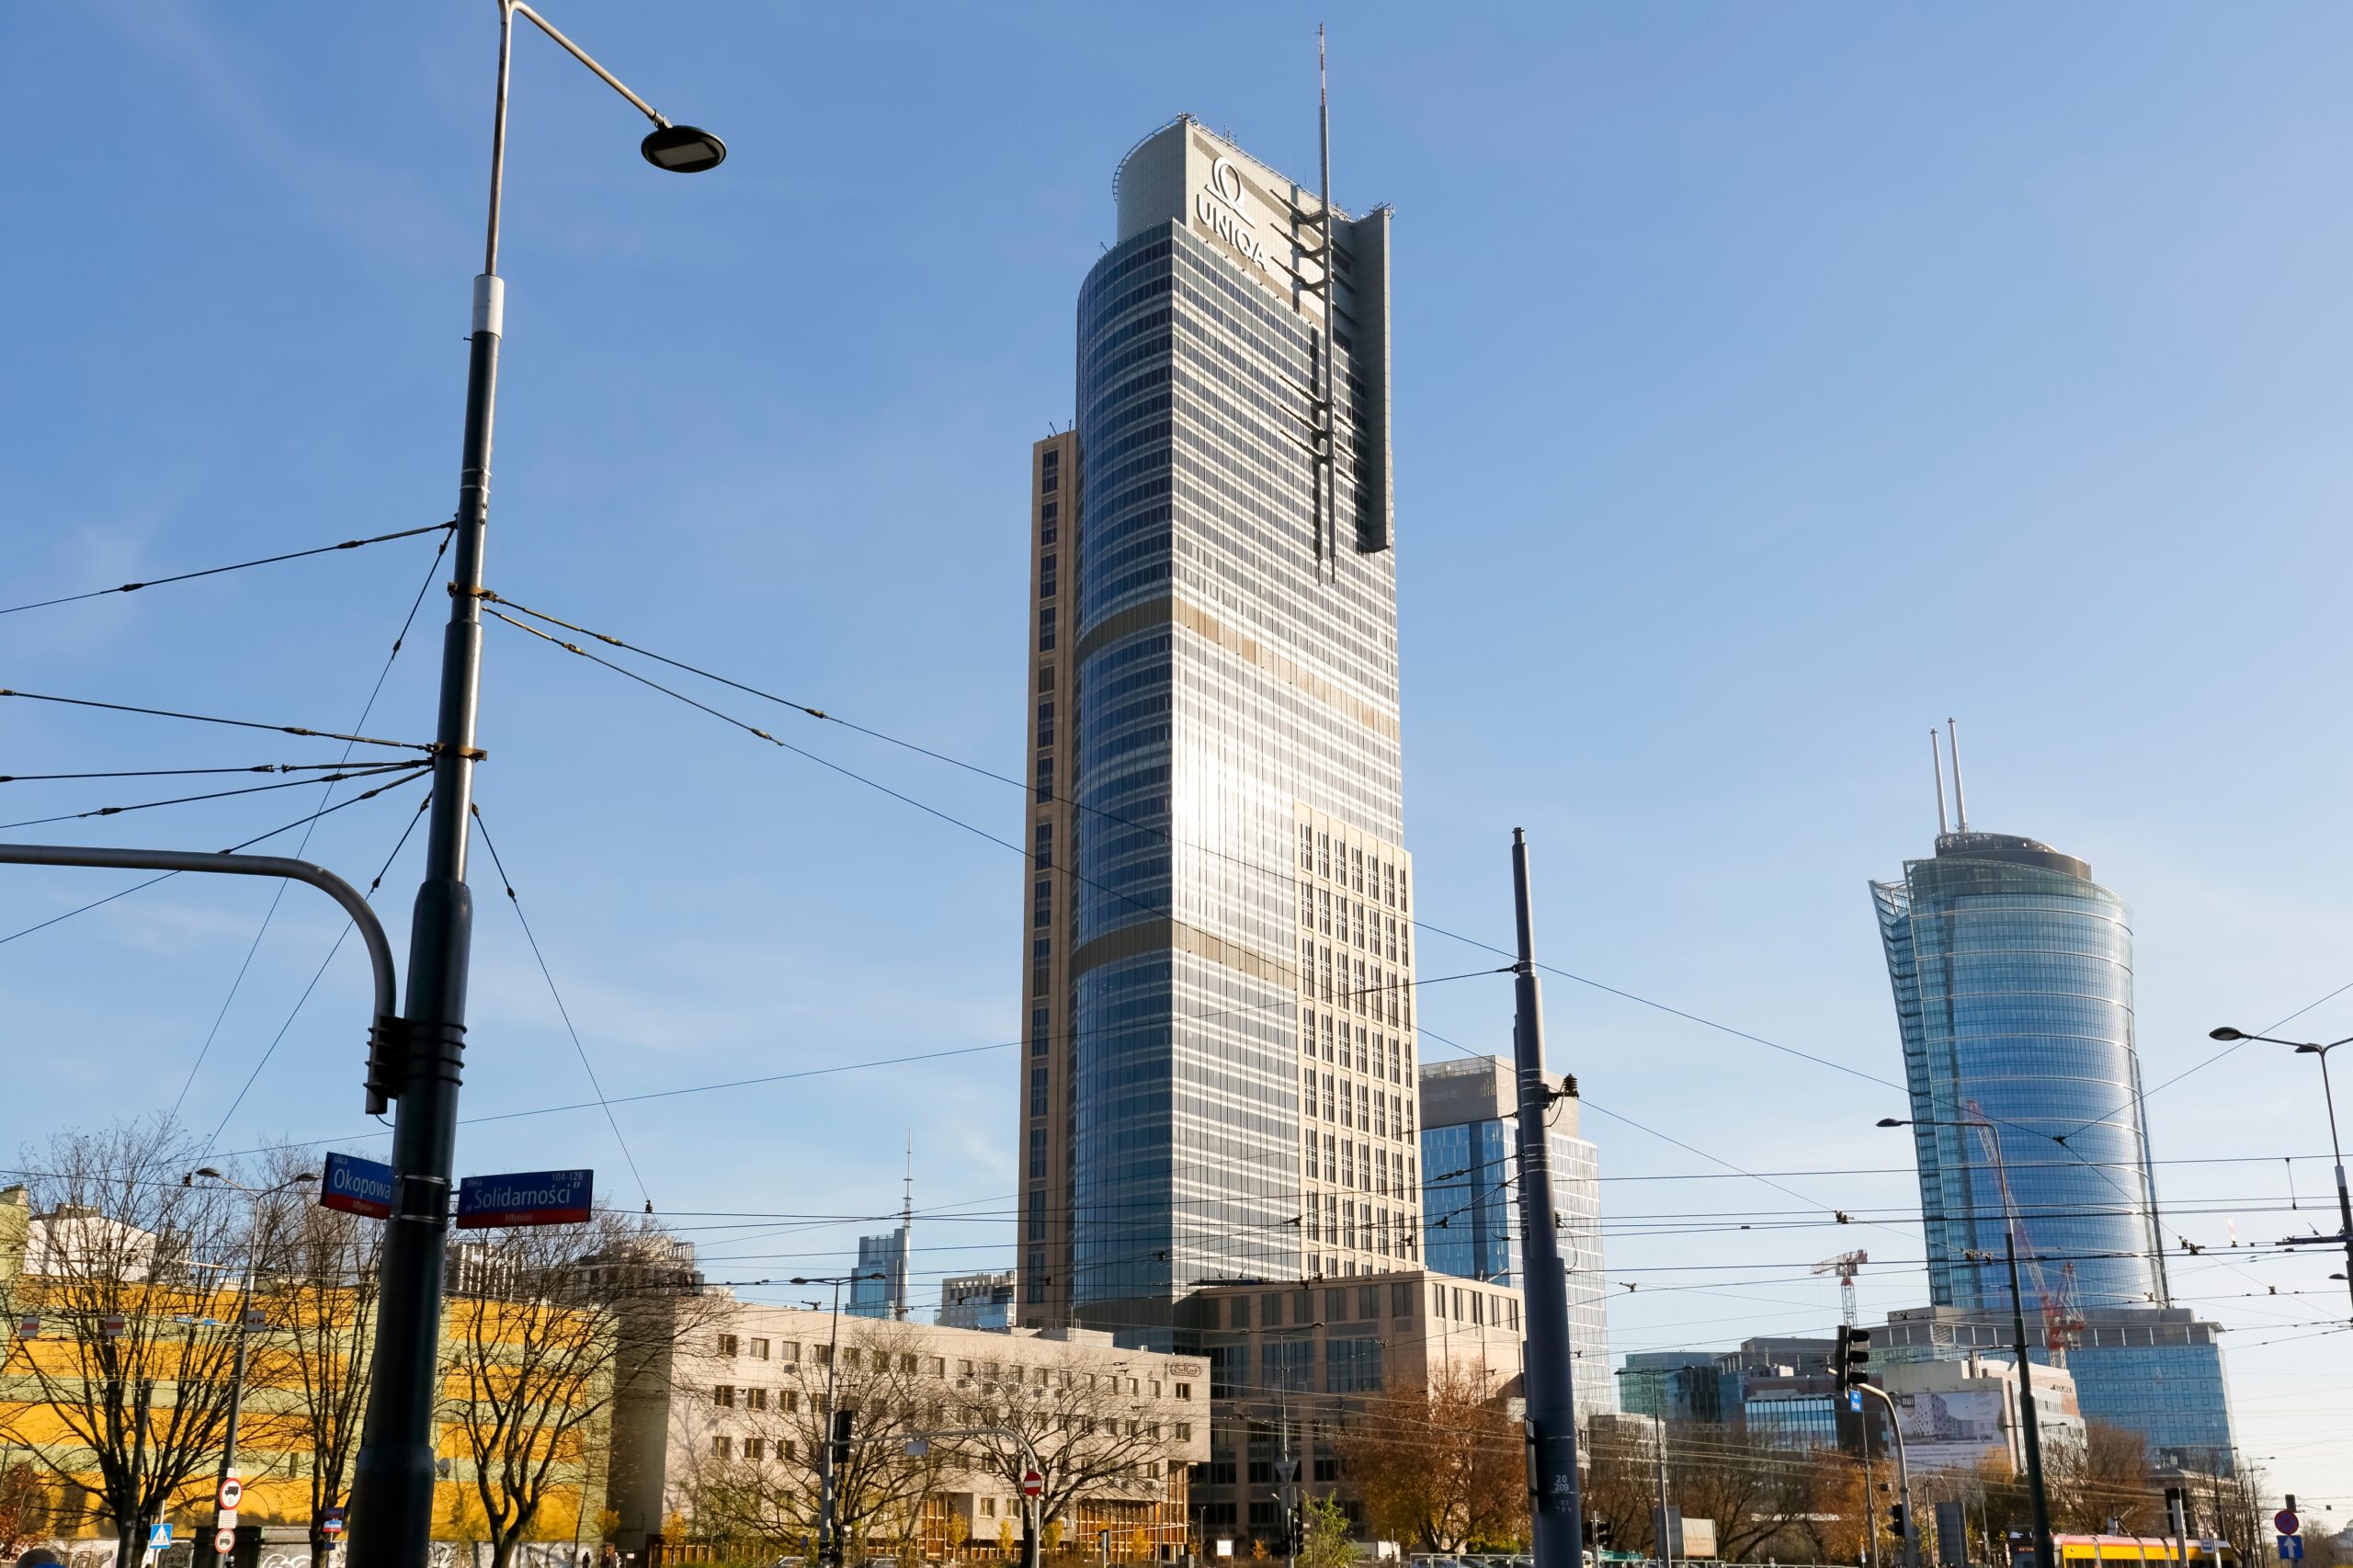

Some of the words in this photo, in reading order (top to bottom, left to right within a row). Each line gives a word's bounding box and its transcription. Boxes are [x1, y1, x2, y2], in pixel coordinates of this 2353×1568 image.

[1196, 193, 1267, 272] UNIQA
[551, 1172, 584, 1182] 104-128
[334, 1168, 392, 1199] Okopowa
[504, 1213, 533, 1224] Młynów
[1555, 1474, 1567, 1483] 20
[1554, 1483, 1569, 1492] 209
